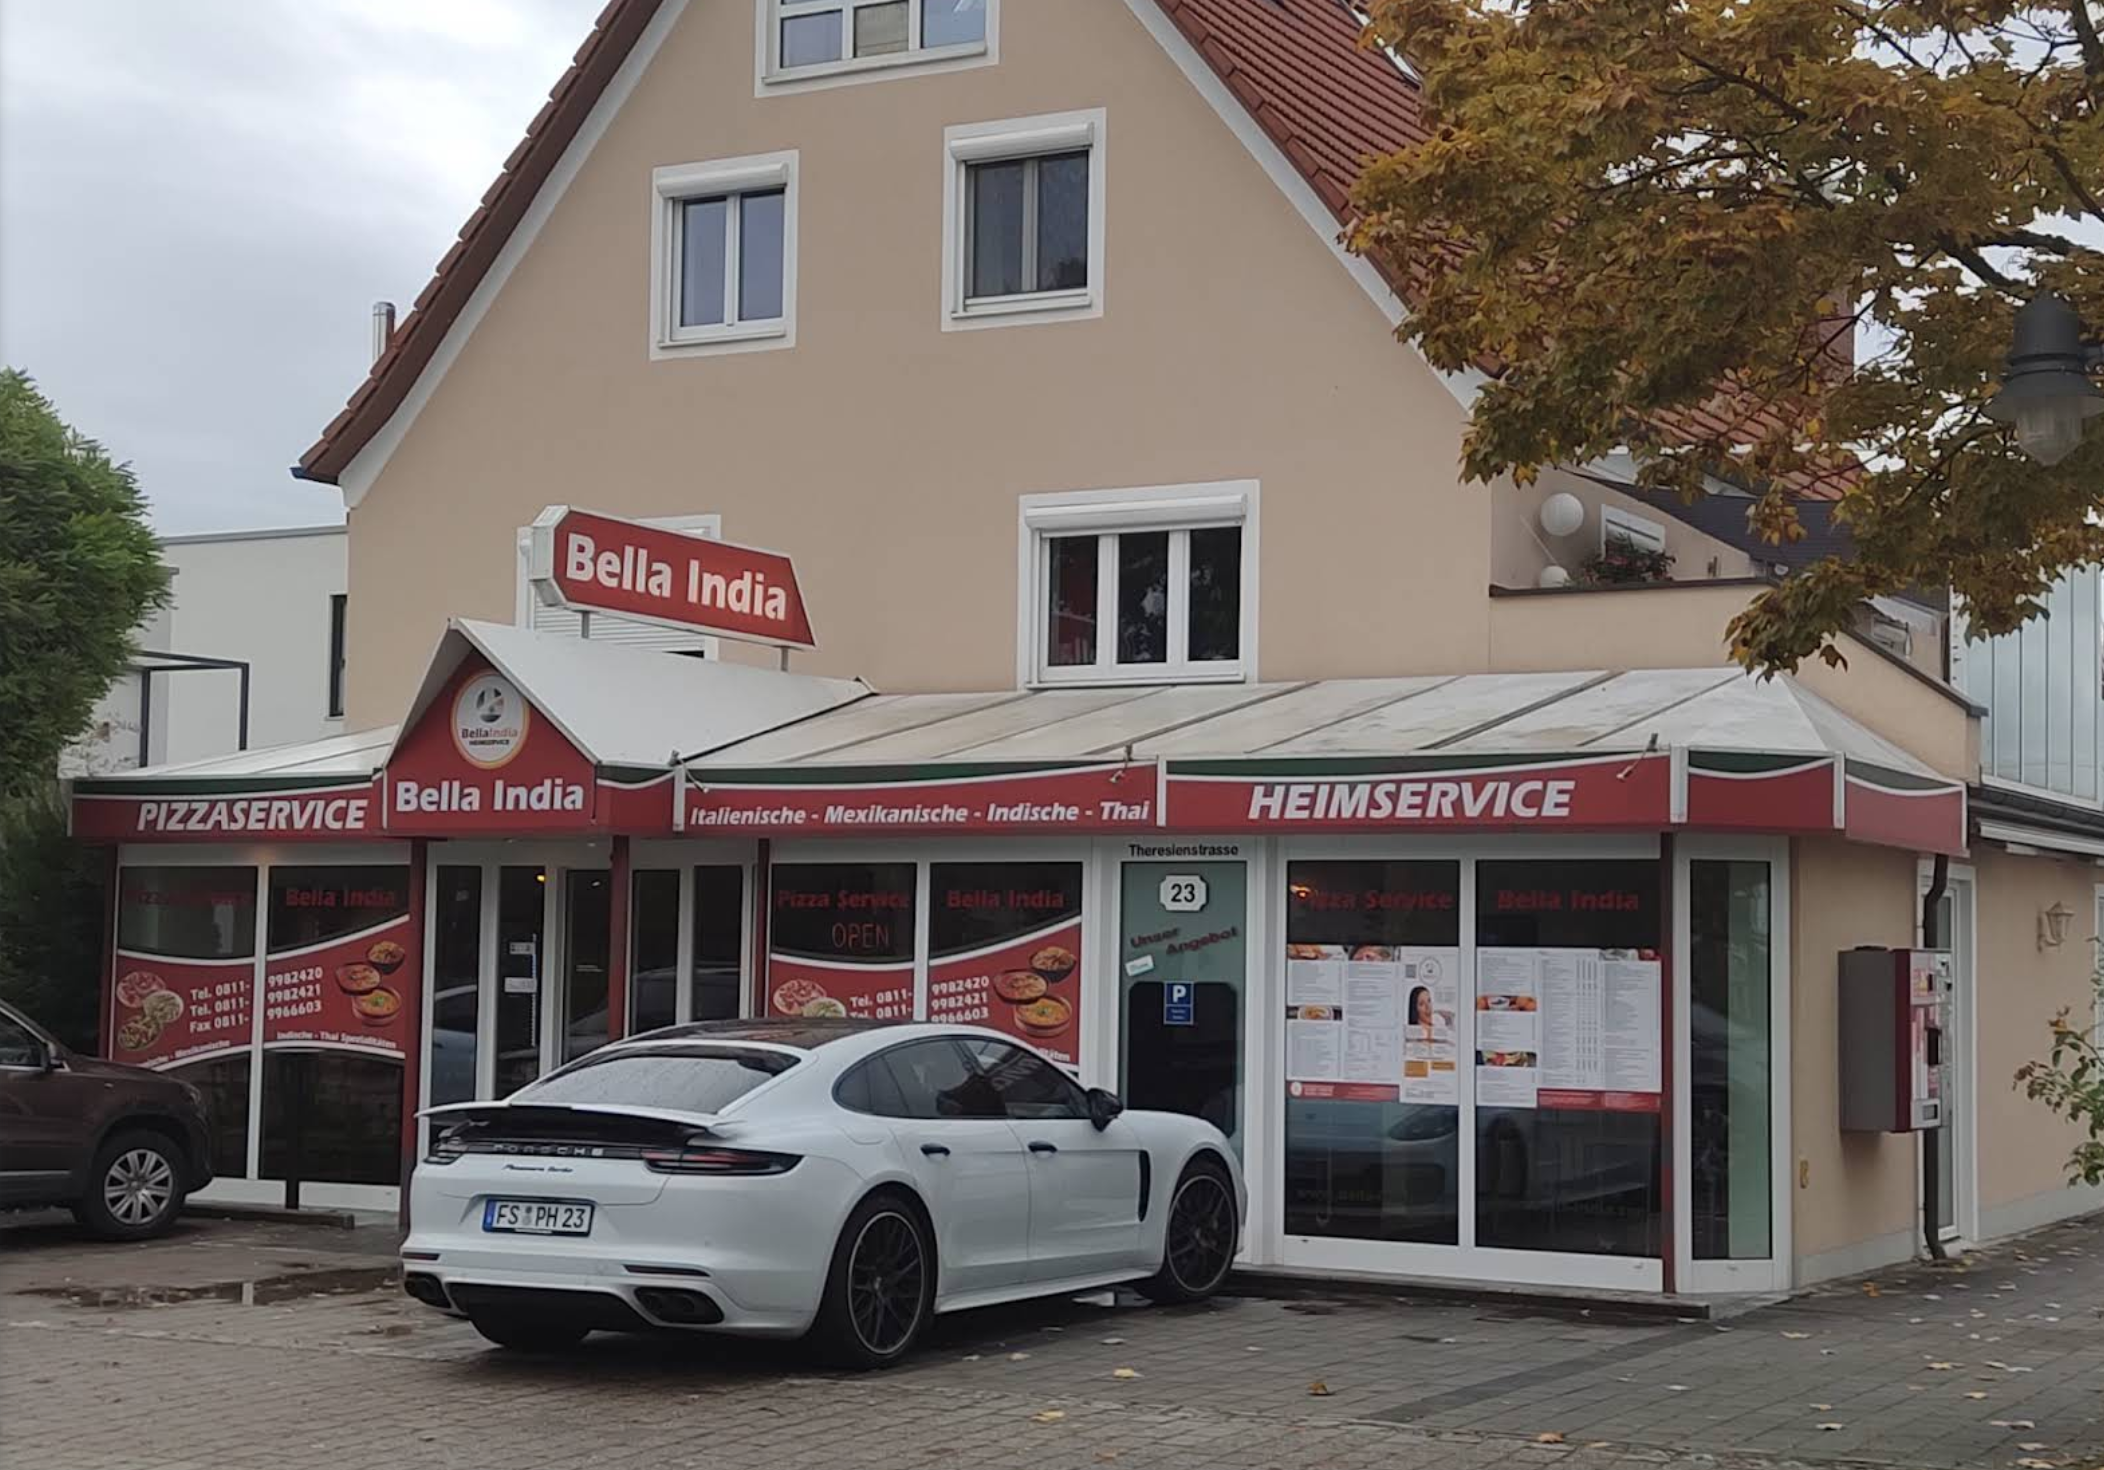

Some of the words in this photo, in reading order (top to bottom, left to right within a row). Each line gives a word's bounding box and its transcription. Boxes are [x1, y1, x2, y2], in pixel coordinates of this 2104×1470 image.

[566, 532, 673, 598] Bella
[687, 559, 787, 620] India
[395, 780, 480, 812] Bella
[493, 778, 584, 811] India
[1248, 780, 1576, 820] HEIMSERVICE
[137, 799, 369, 832] PIZZASERVICE
[690, 806, 806, 825] Italienische
[823, 804, 968, 824] Mexikanische
[986, 803, 1078, 821] Indische
[1100, 800, 1150, 820] Thai
[1129, 843, 1238, 857] Theresienstrasse
[286, 886, 336, 906] Bella
[343, 886, 395, 906] India
[777, 889, 829, 908] Pizza
[947, 890, 1000, 908] Bella
[1009, 889, 1064, 909] India
[1170, 883, 1196, 903] 23
[1497, 889, 1563, 911] Bella
[1570, 889, 1639, 911] India
[832, 922, 890, 948] OPEN
[1131, 927, 1181, 948] Unser
[1166, 926, 1239, 955] Angebot
[190, 987, 212, 1001] Tel.
[267, 966, 323, 987] 9982420
[850, 994, 873, 1008] Tel.
[931, 975, 990, 996] 9982420
[1173, 985, 1187, 1003] P
[189, 1003, 211, 1017] Tel.
[267, 983, 321, 1003] 9982421
[931, 991, 988, 1011] 9982421
[189, 1020, 211, 1033] Fax
[266, 1000, 322, 1020] 9966603
[493, 1144, 604, 1156] PORSCHE
[496, 1204, 520, 1226] FS
[535, 1205, 559, 1228] PH
[562, 1207, 586, 1229] 23
